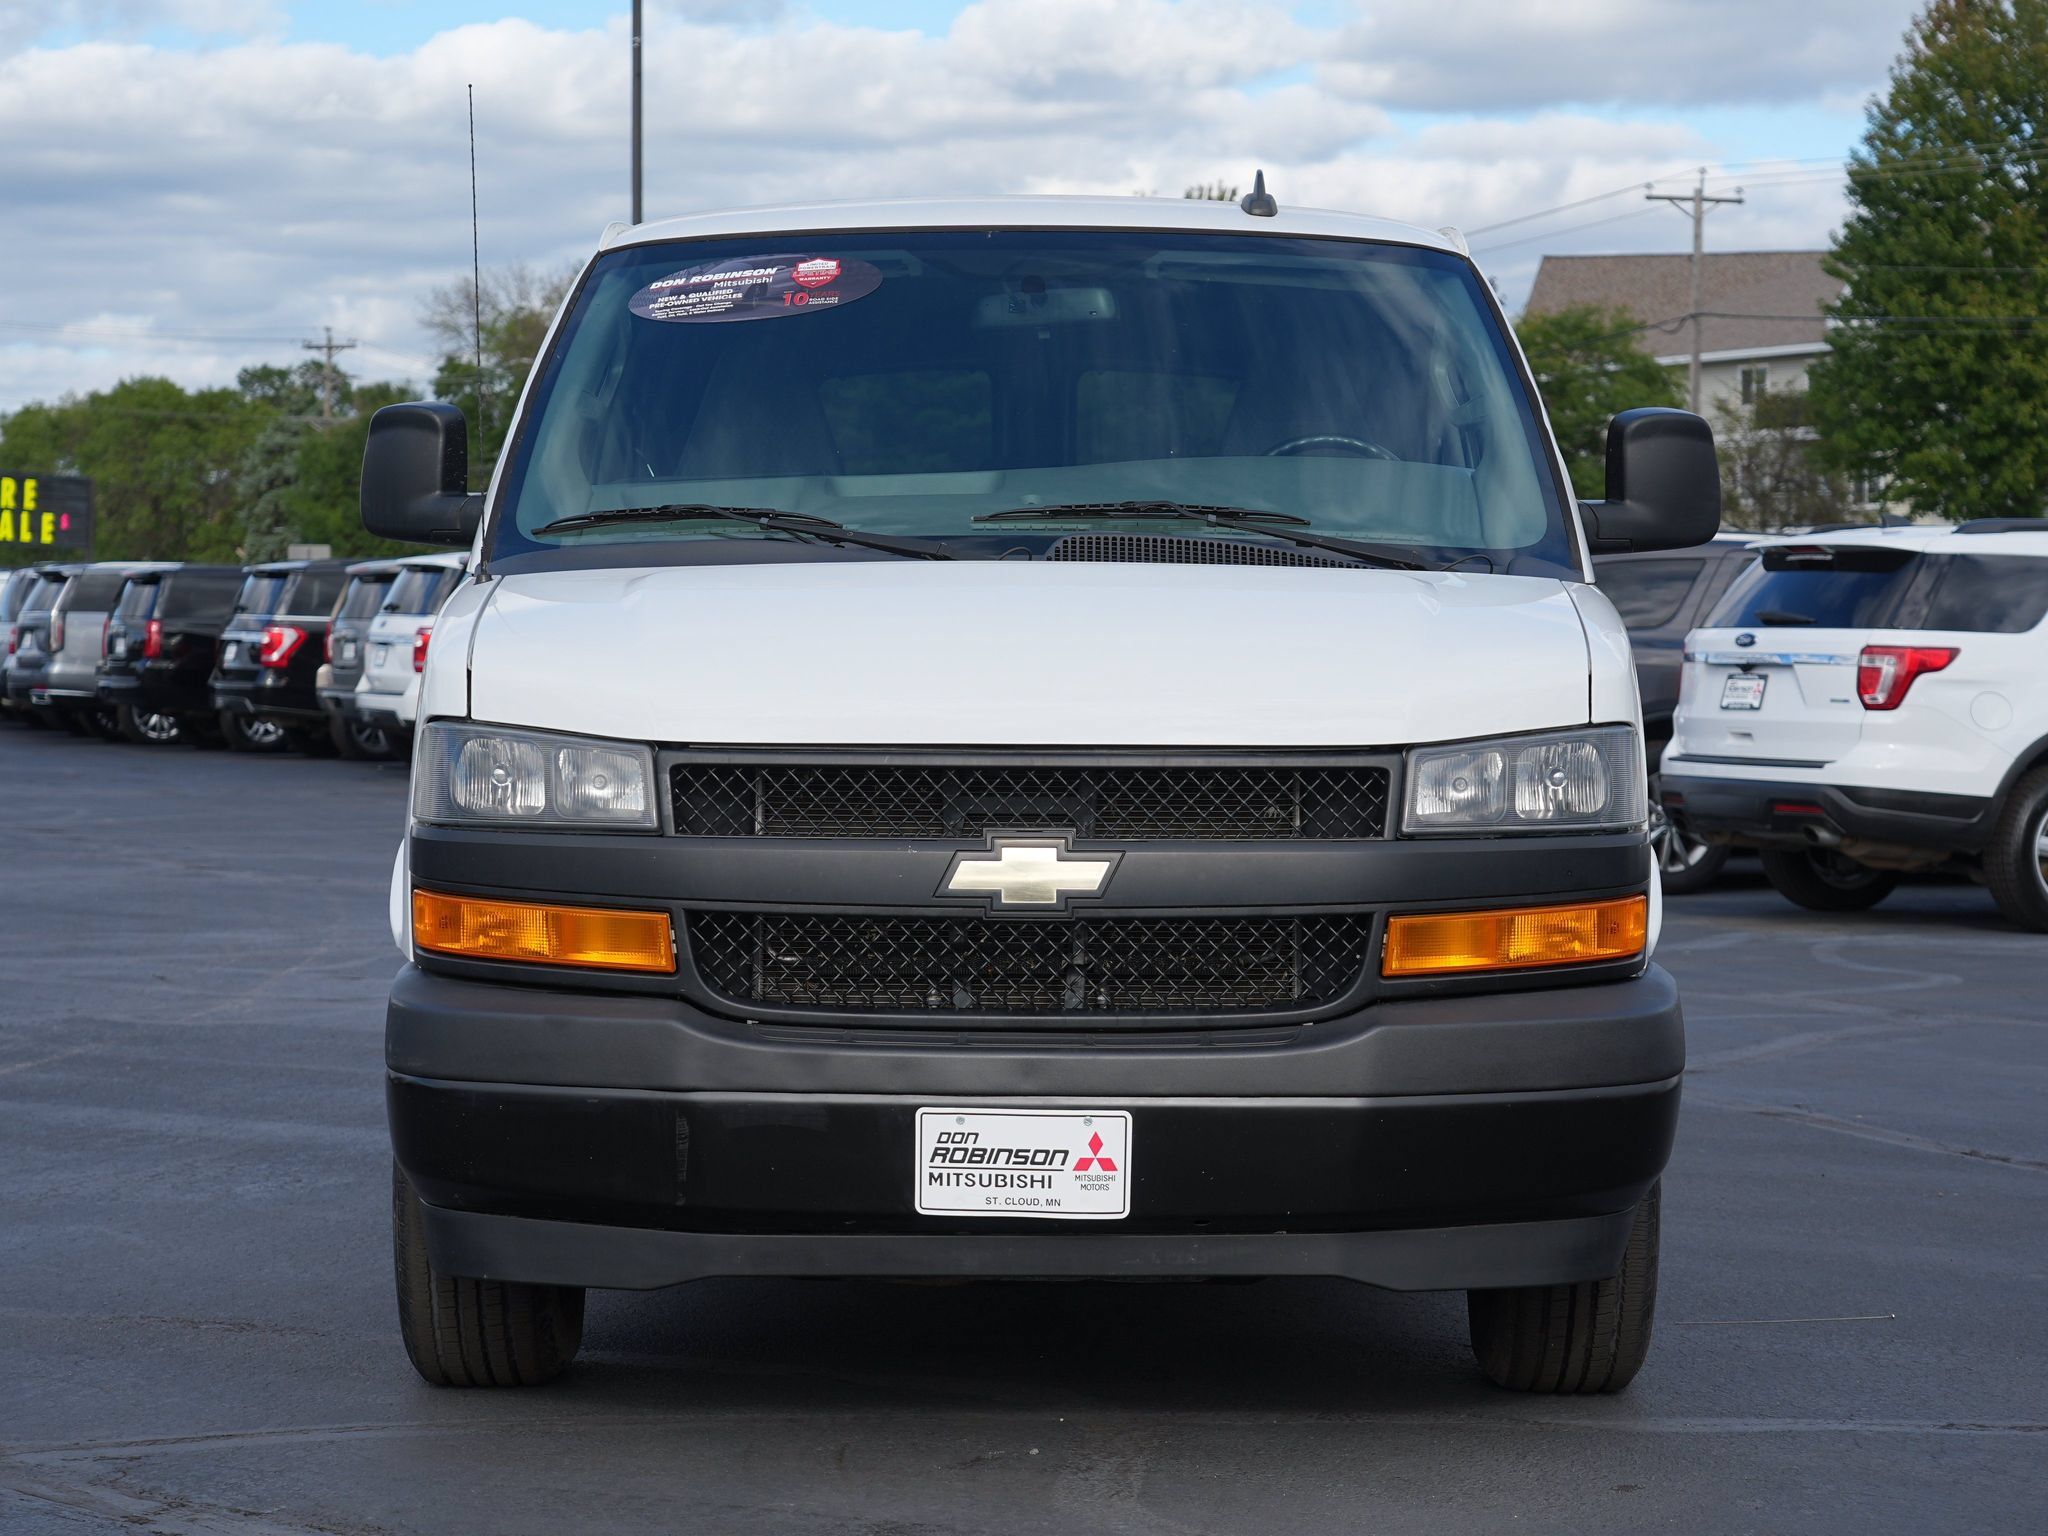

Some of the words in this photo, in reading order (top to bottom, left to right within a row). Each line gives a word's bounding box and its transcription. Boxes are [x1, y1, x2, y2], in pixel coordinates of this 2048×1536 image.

[650, 277, 686, 290] DON
[690, 267, 778, 283] ROBINSON
[713, 276, 773, 288] Mitsubishi
[648, 298, 700, 310] PRE-OWNED
[702, 292, 743, 302] VEHICLES
[657, 295, 678, 303] NEW
[688, 288, 733, 298] QUALIFIED
[783, 291, 809, 306] 10
[936, 1132, 980, 1144] DON
[929, 1147, 1070, 1167] ROBINSON
[928, 1172, 1053, 1189] MITSUBISHI
[1074, 1174, 1116, 1182] MITSUBISHI
[1080, 1183, 1110, 1191] MOTORS
[985, 1196, 1002, 1206] ST.
[1005, 1197, 1043, 1207] CLOUD,
[1046, 1198, 1061, 1207] MN
